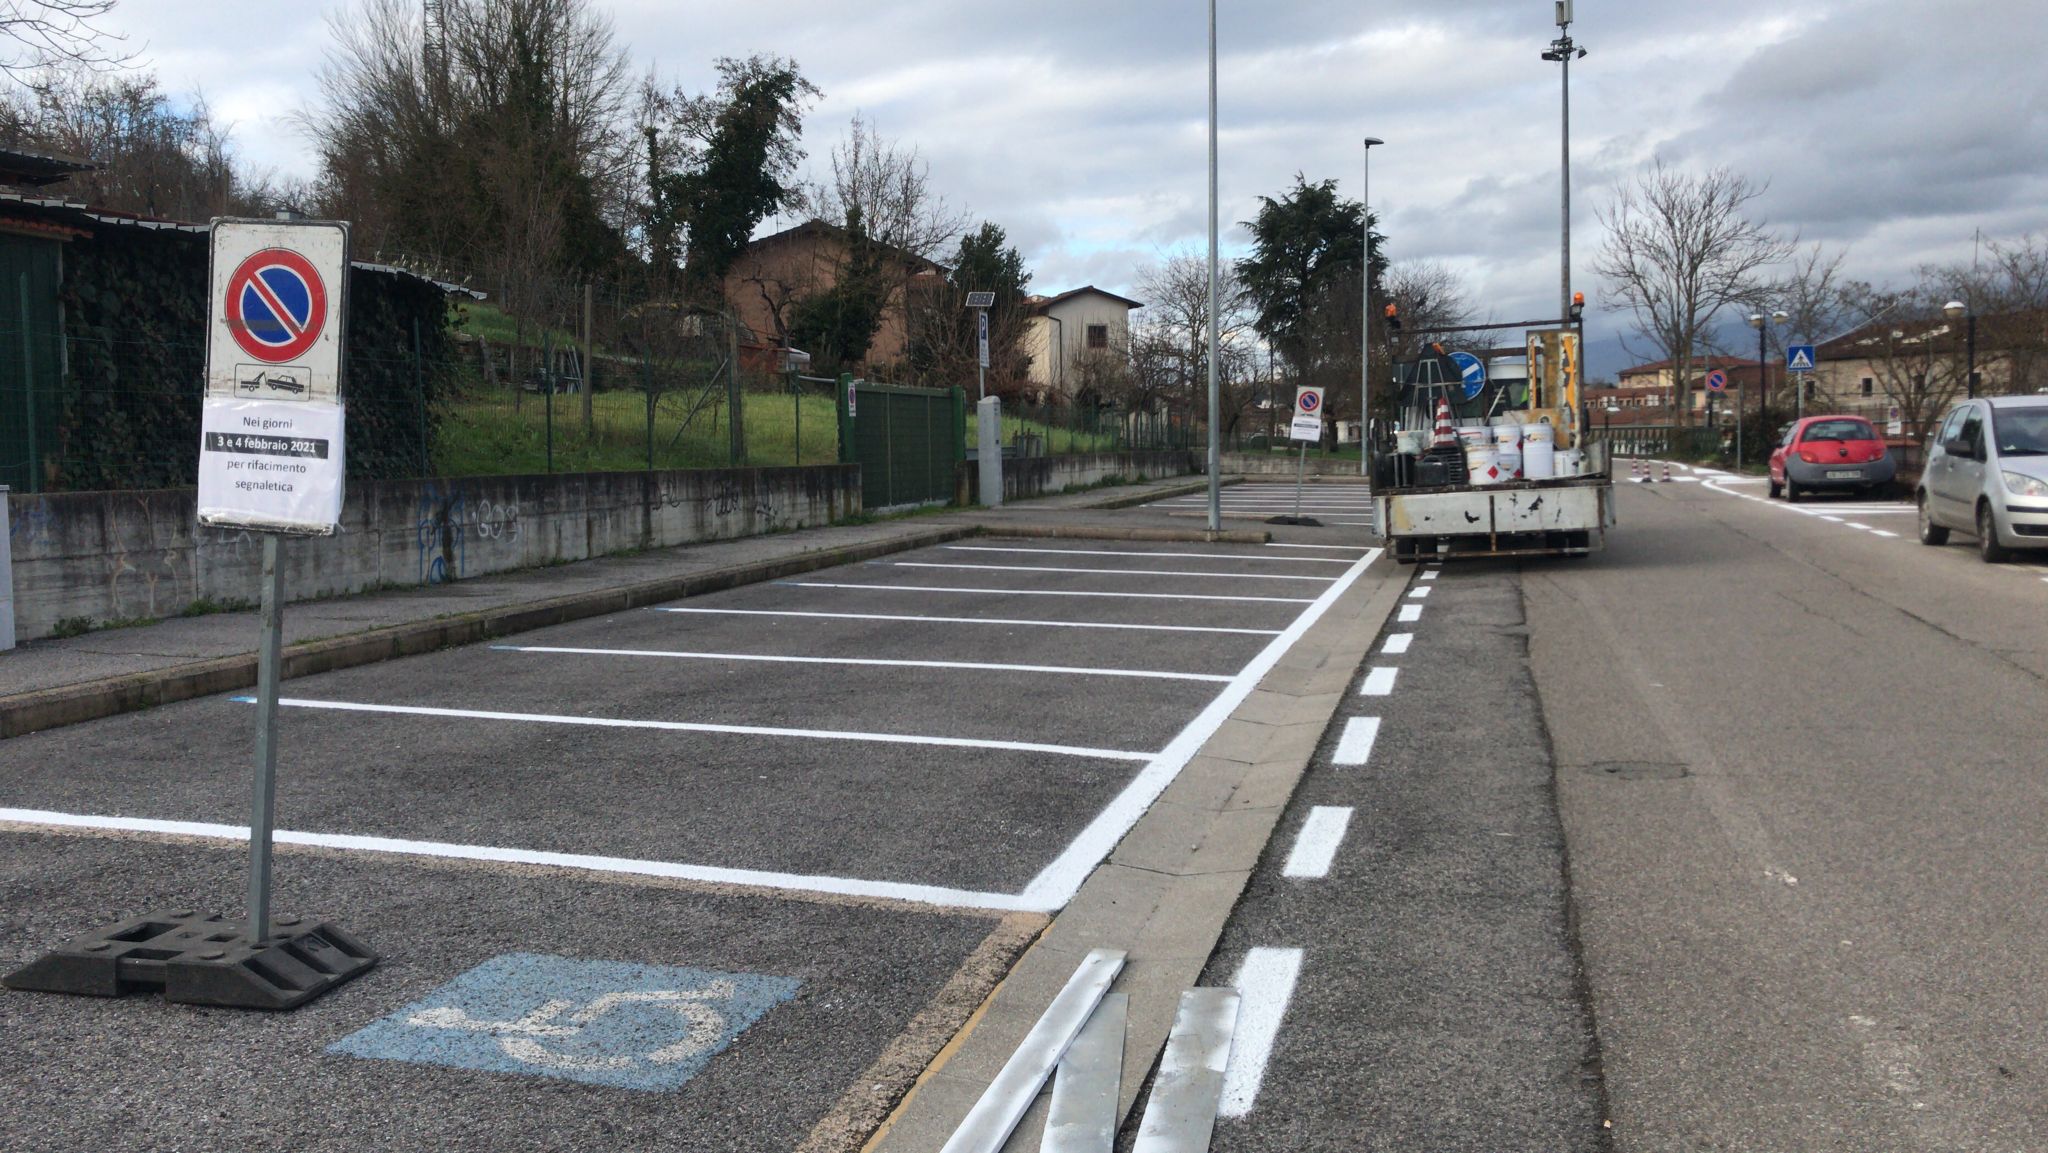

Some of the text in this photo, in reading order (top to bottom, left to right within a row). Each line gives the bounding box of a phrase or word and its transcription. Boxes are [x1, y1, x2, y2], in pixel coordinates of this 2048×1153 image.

[243, 416, 293, 430] Nei giorni
[217, 436, 316, 453] 3 e 4 febbraio 2021
[227, 459, 307, 474] per rifacimento
[235, 480, 294, 493] segnaletica
